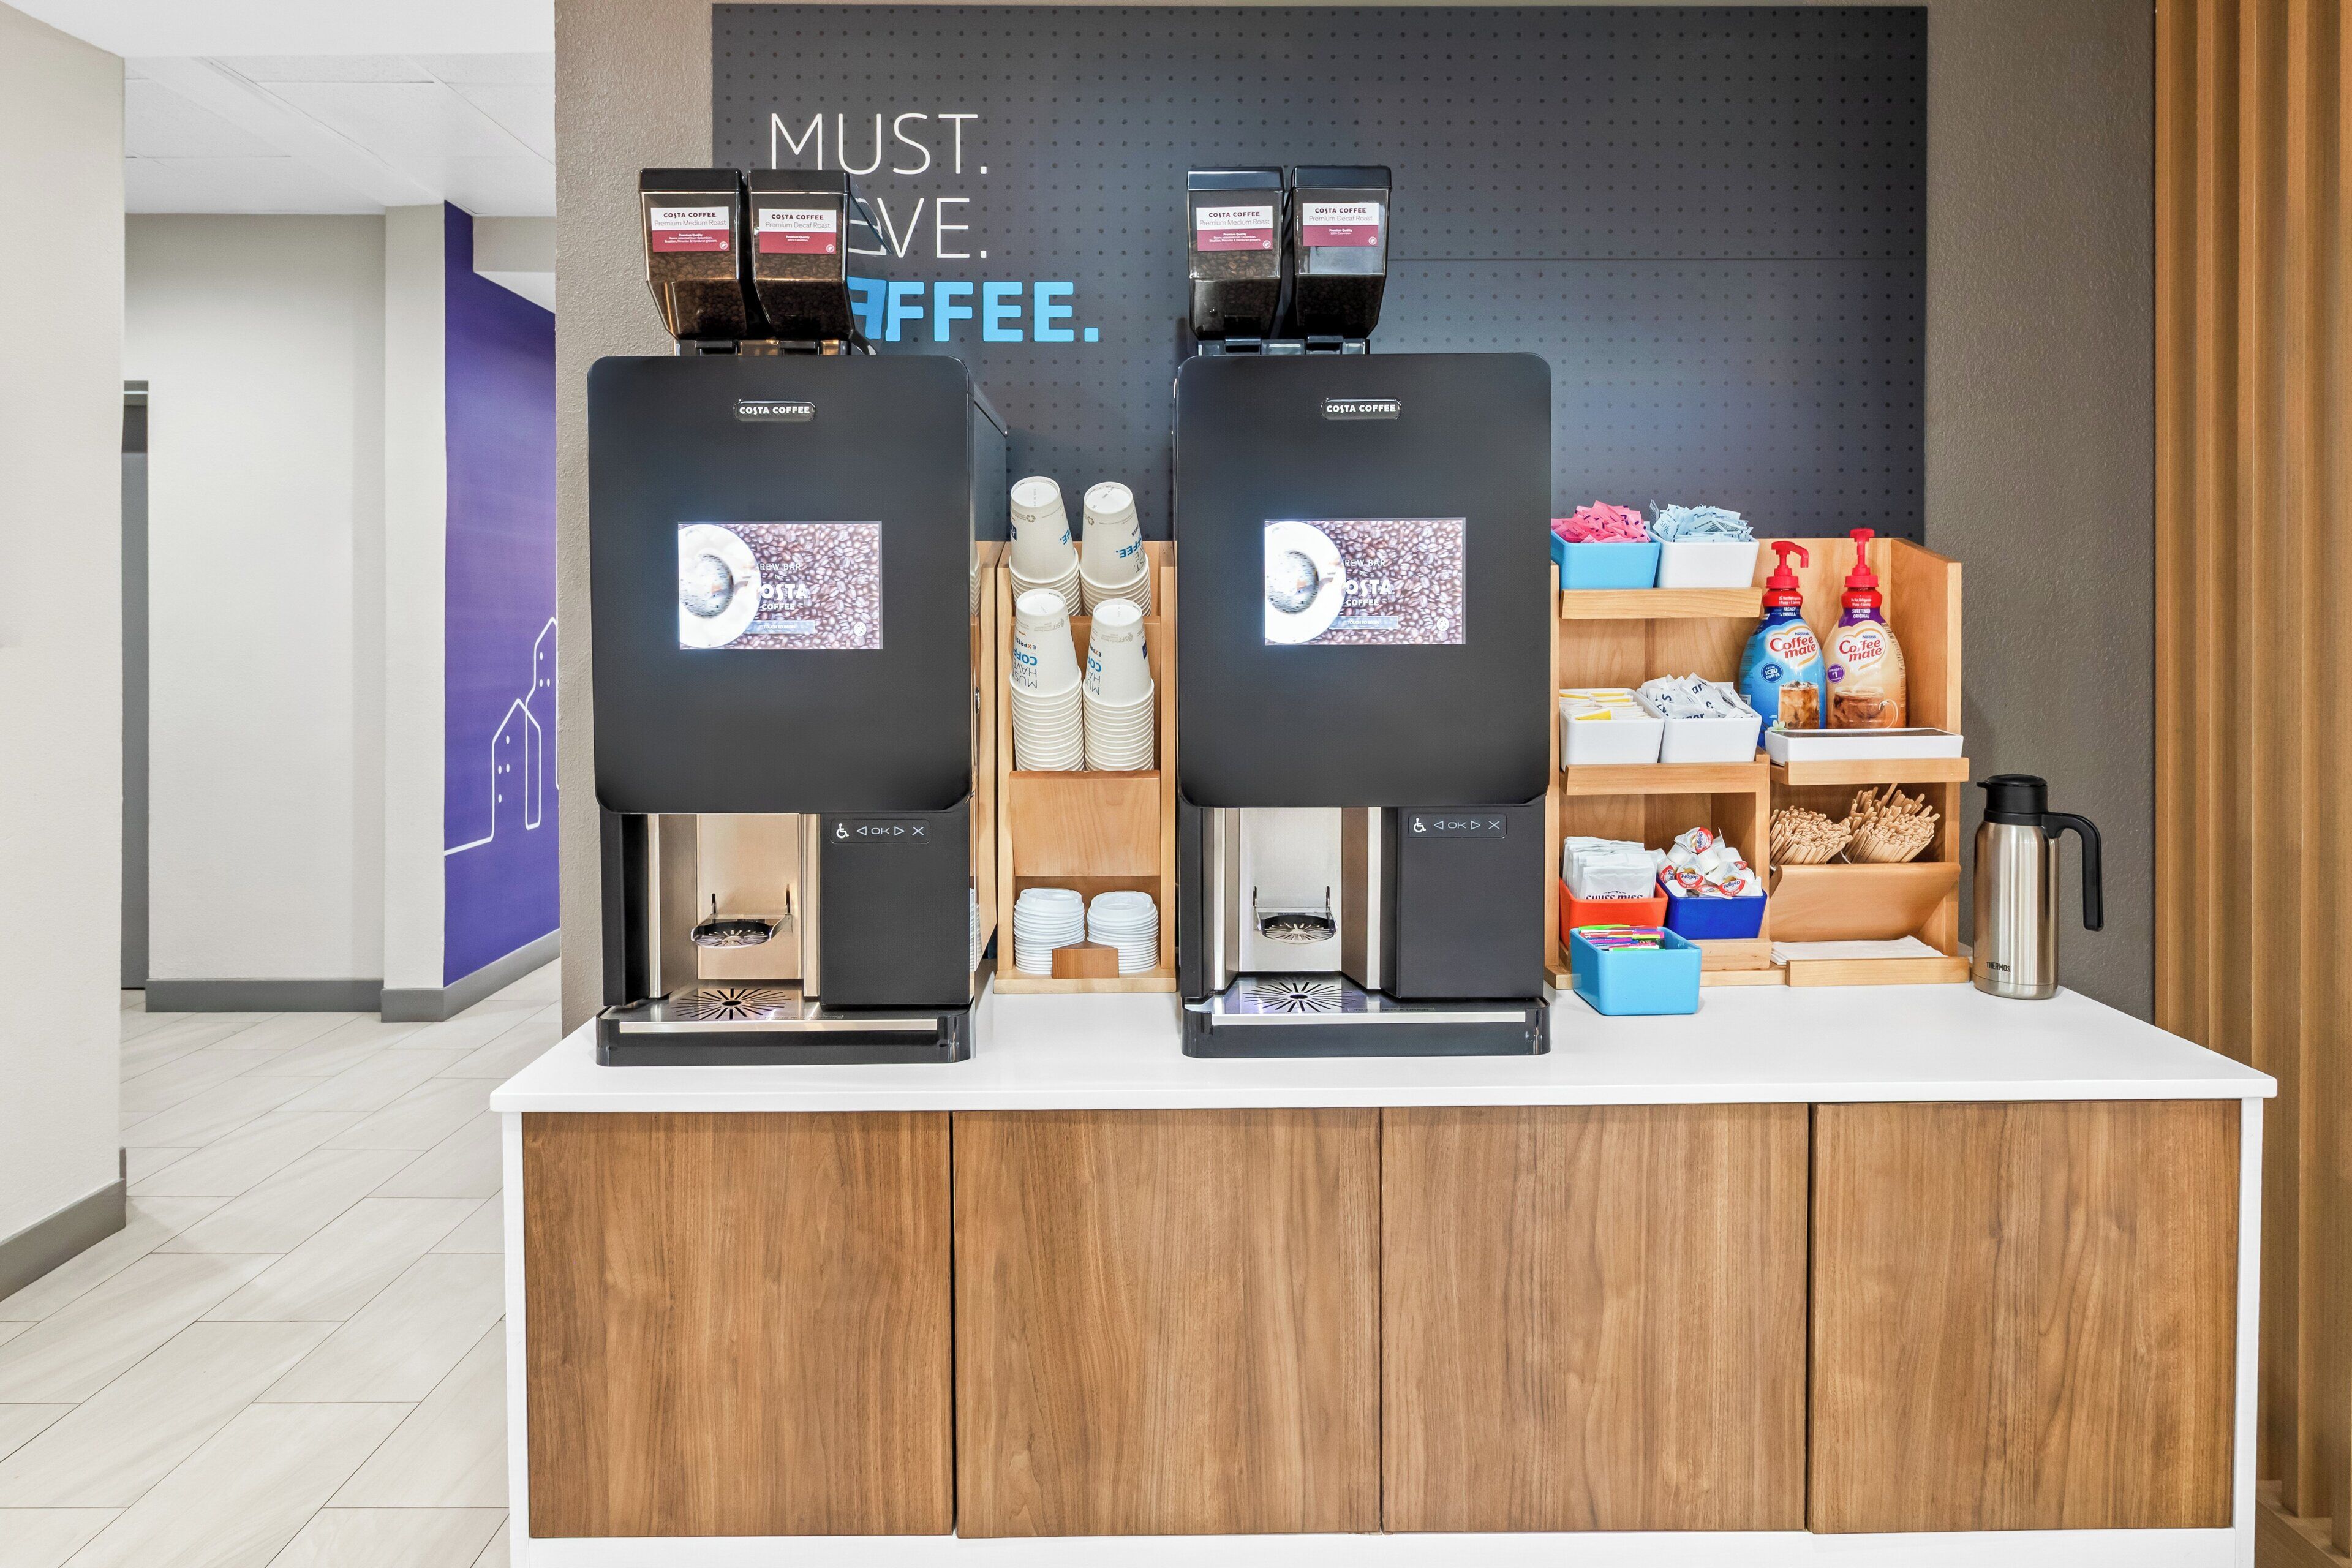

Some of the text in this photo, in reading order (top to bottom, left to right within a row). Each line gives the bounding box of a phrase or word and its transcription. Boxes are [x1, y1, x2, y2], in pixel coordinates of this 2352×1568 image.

[770, 113, 987, 175] MUST.
[886, 281, 1099, 343] FFEE.
[739, 407, 770, 415] COSTA
[1326, 405, 1356, 413] COSTA
[761, 583, 808, 601] OSTA
[1345, 579, 1392, 597] OSTA
[1770, 636, 1813, 652] Coffee
[1784, 644, 1816, 658] mate
[1013, 647, 1038, 666] COFF
[1849, 648, 1882, 662] mate
[1986, 961, 2011, 972] THERMOS
